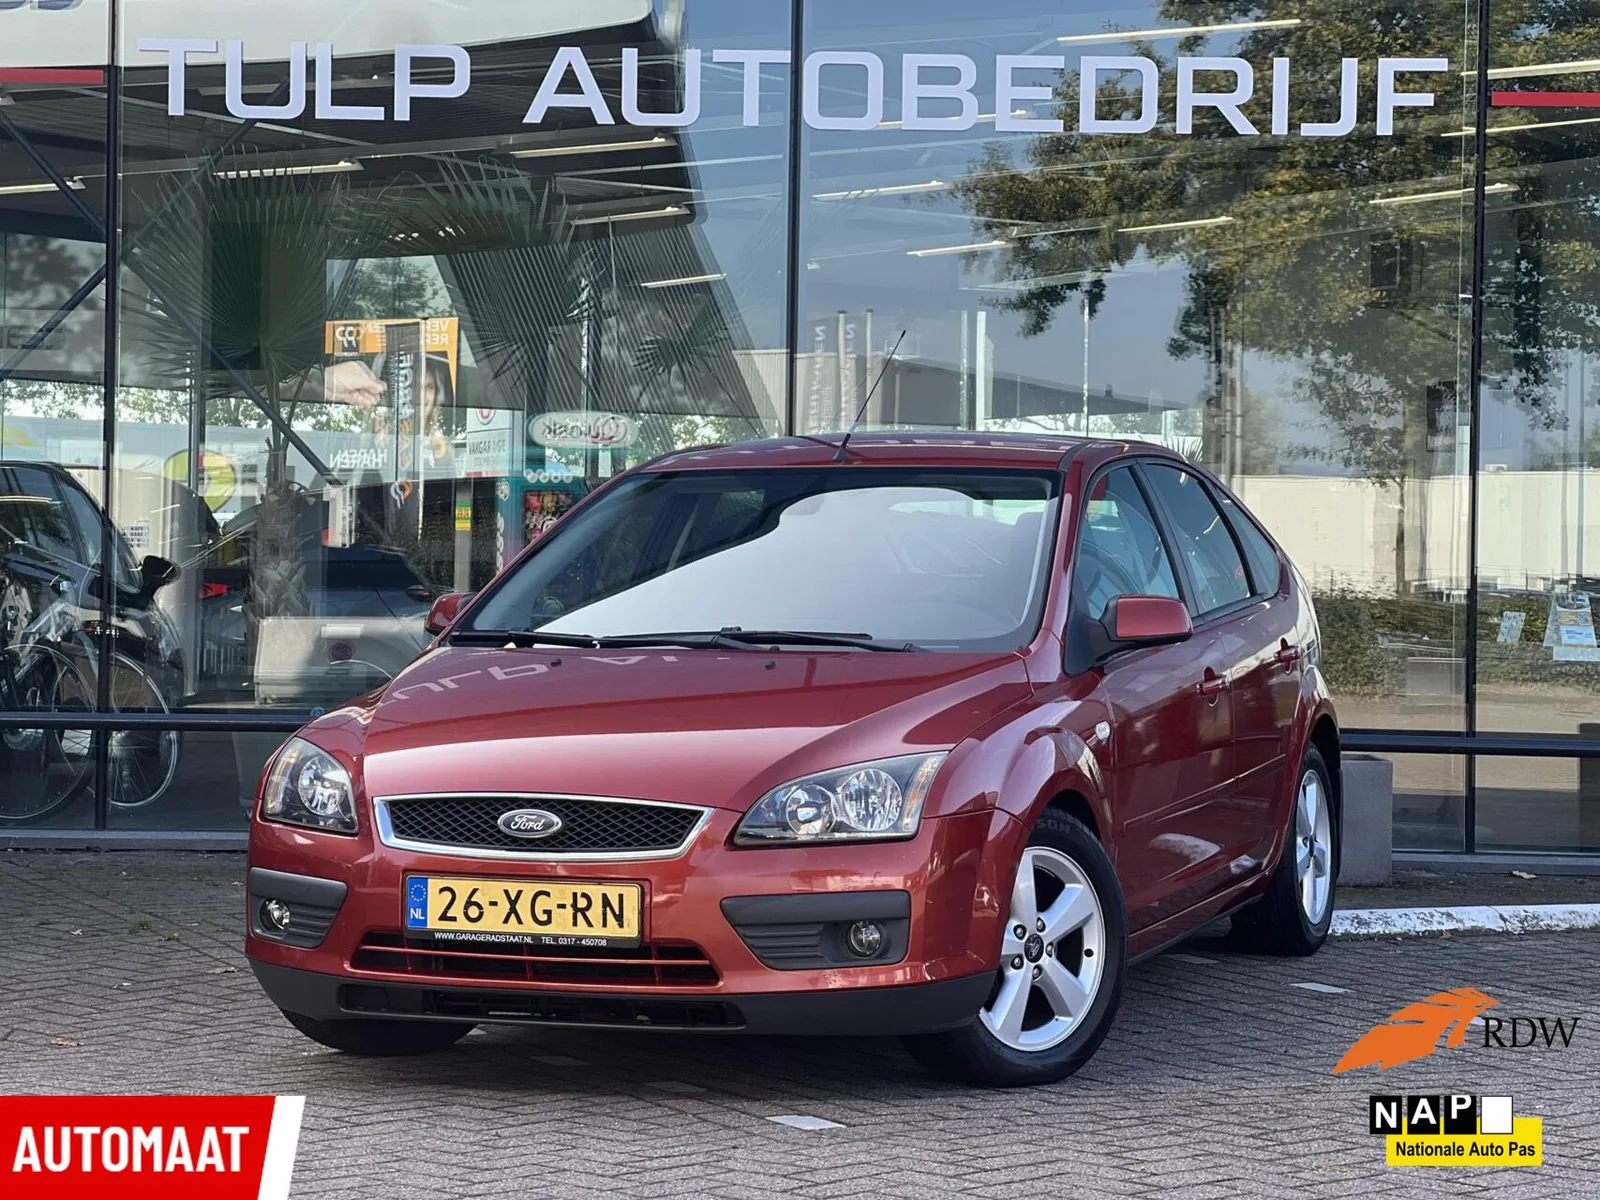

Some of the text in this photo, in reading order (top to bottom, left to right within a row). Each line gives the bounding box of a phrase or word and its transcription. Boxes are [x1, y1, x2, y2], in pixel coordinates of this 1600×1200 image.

[137, 38, 1449, 137] TULP AUTOBEDRIJF
[510, 814, 546, 831] Ford
[410, 908, 425, 920] NL
[437, 886, 625, 929] 26-XG-RN
[434, 931, 534, 944] WWW.GARAGERADSTAAT.NL
[541, 936, 556, 945] TEL.
[558, 937, 575, 946] 0317
[581, 938, 607, 947] 450708
